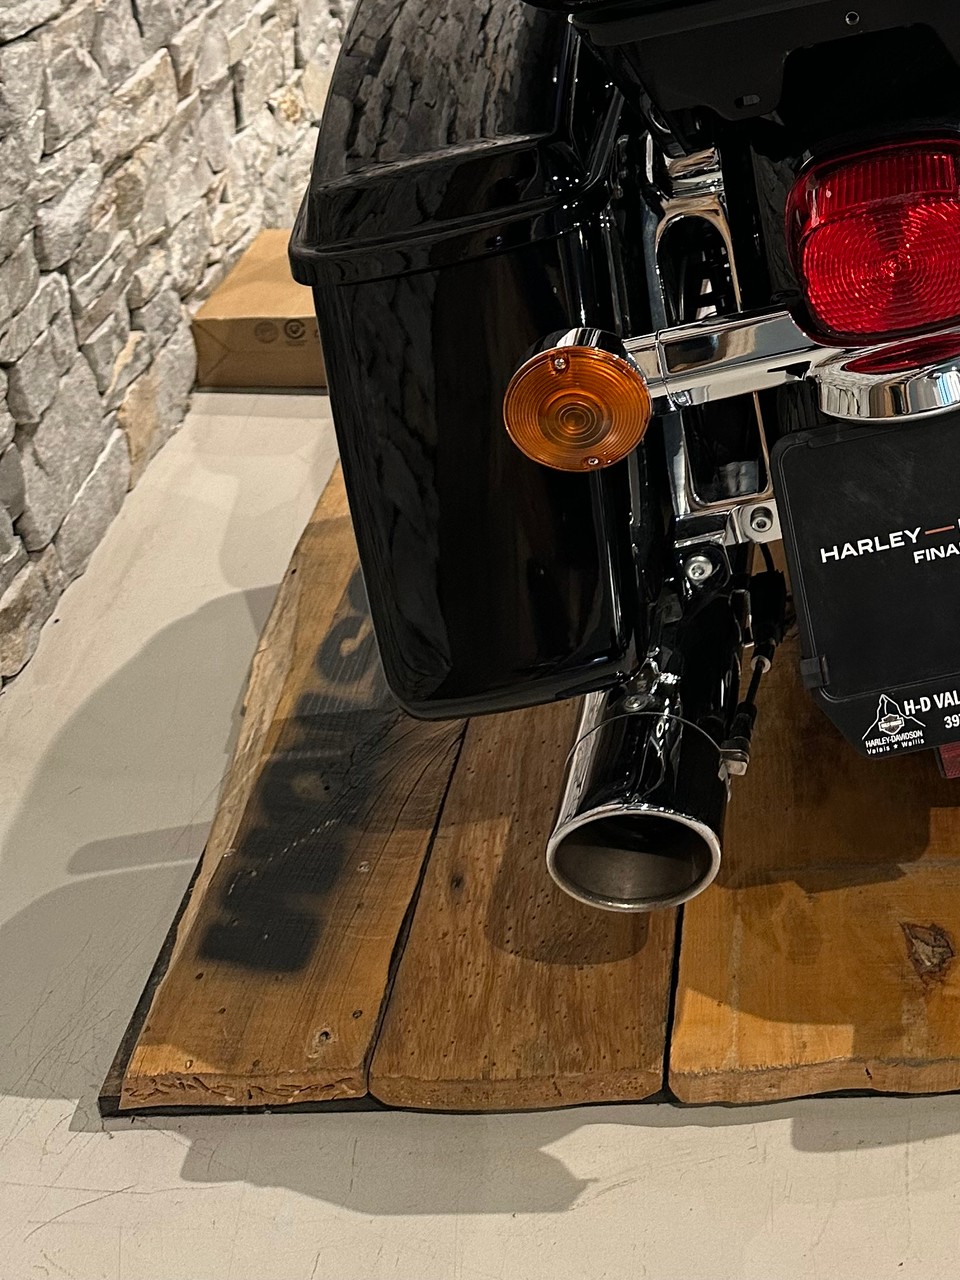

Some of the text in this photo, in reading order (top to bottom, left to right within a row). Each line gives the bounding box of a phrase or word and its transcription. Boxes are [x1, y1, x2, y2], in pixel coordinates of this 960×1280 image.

[904, 696, 932, 716] H-D
[865, 730, 924, 748] HARLEY-DAVIDSON
[867, 738, 925, 755] Valais Wallis
